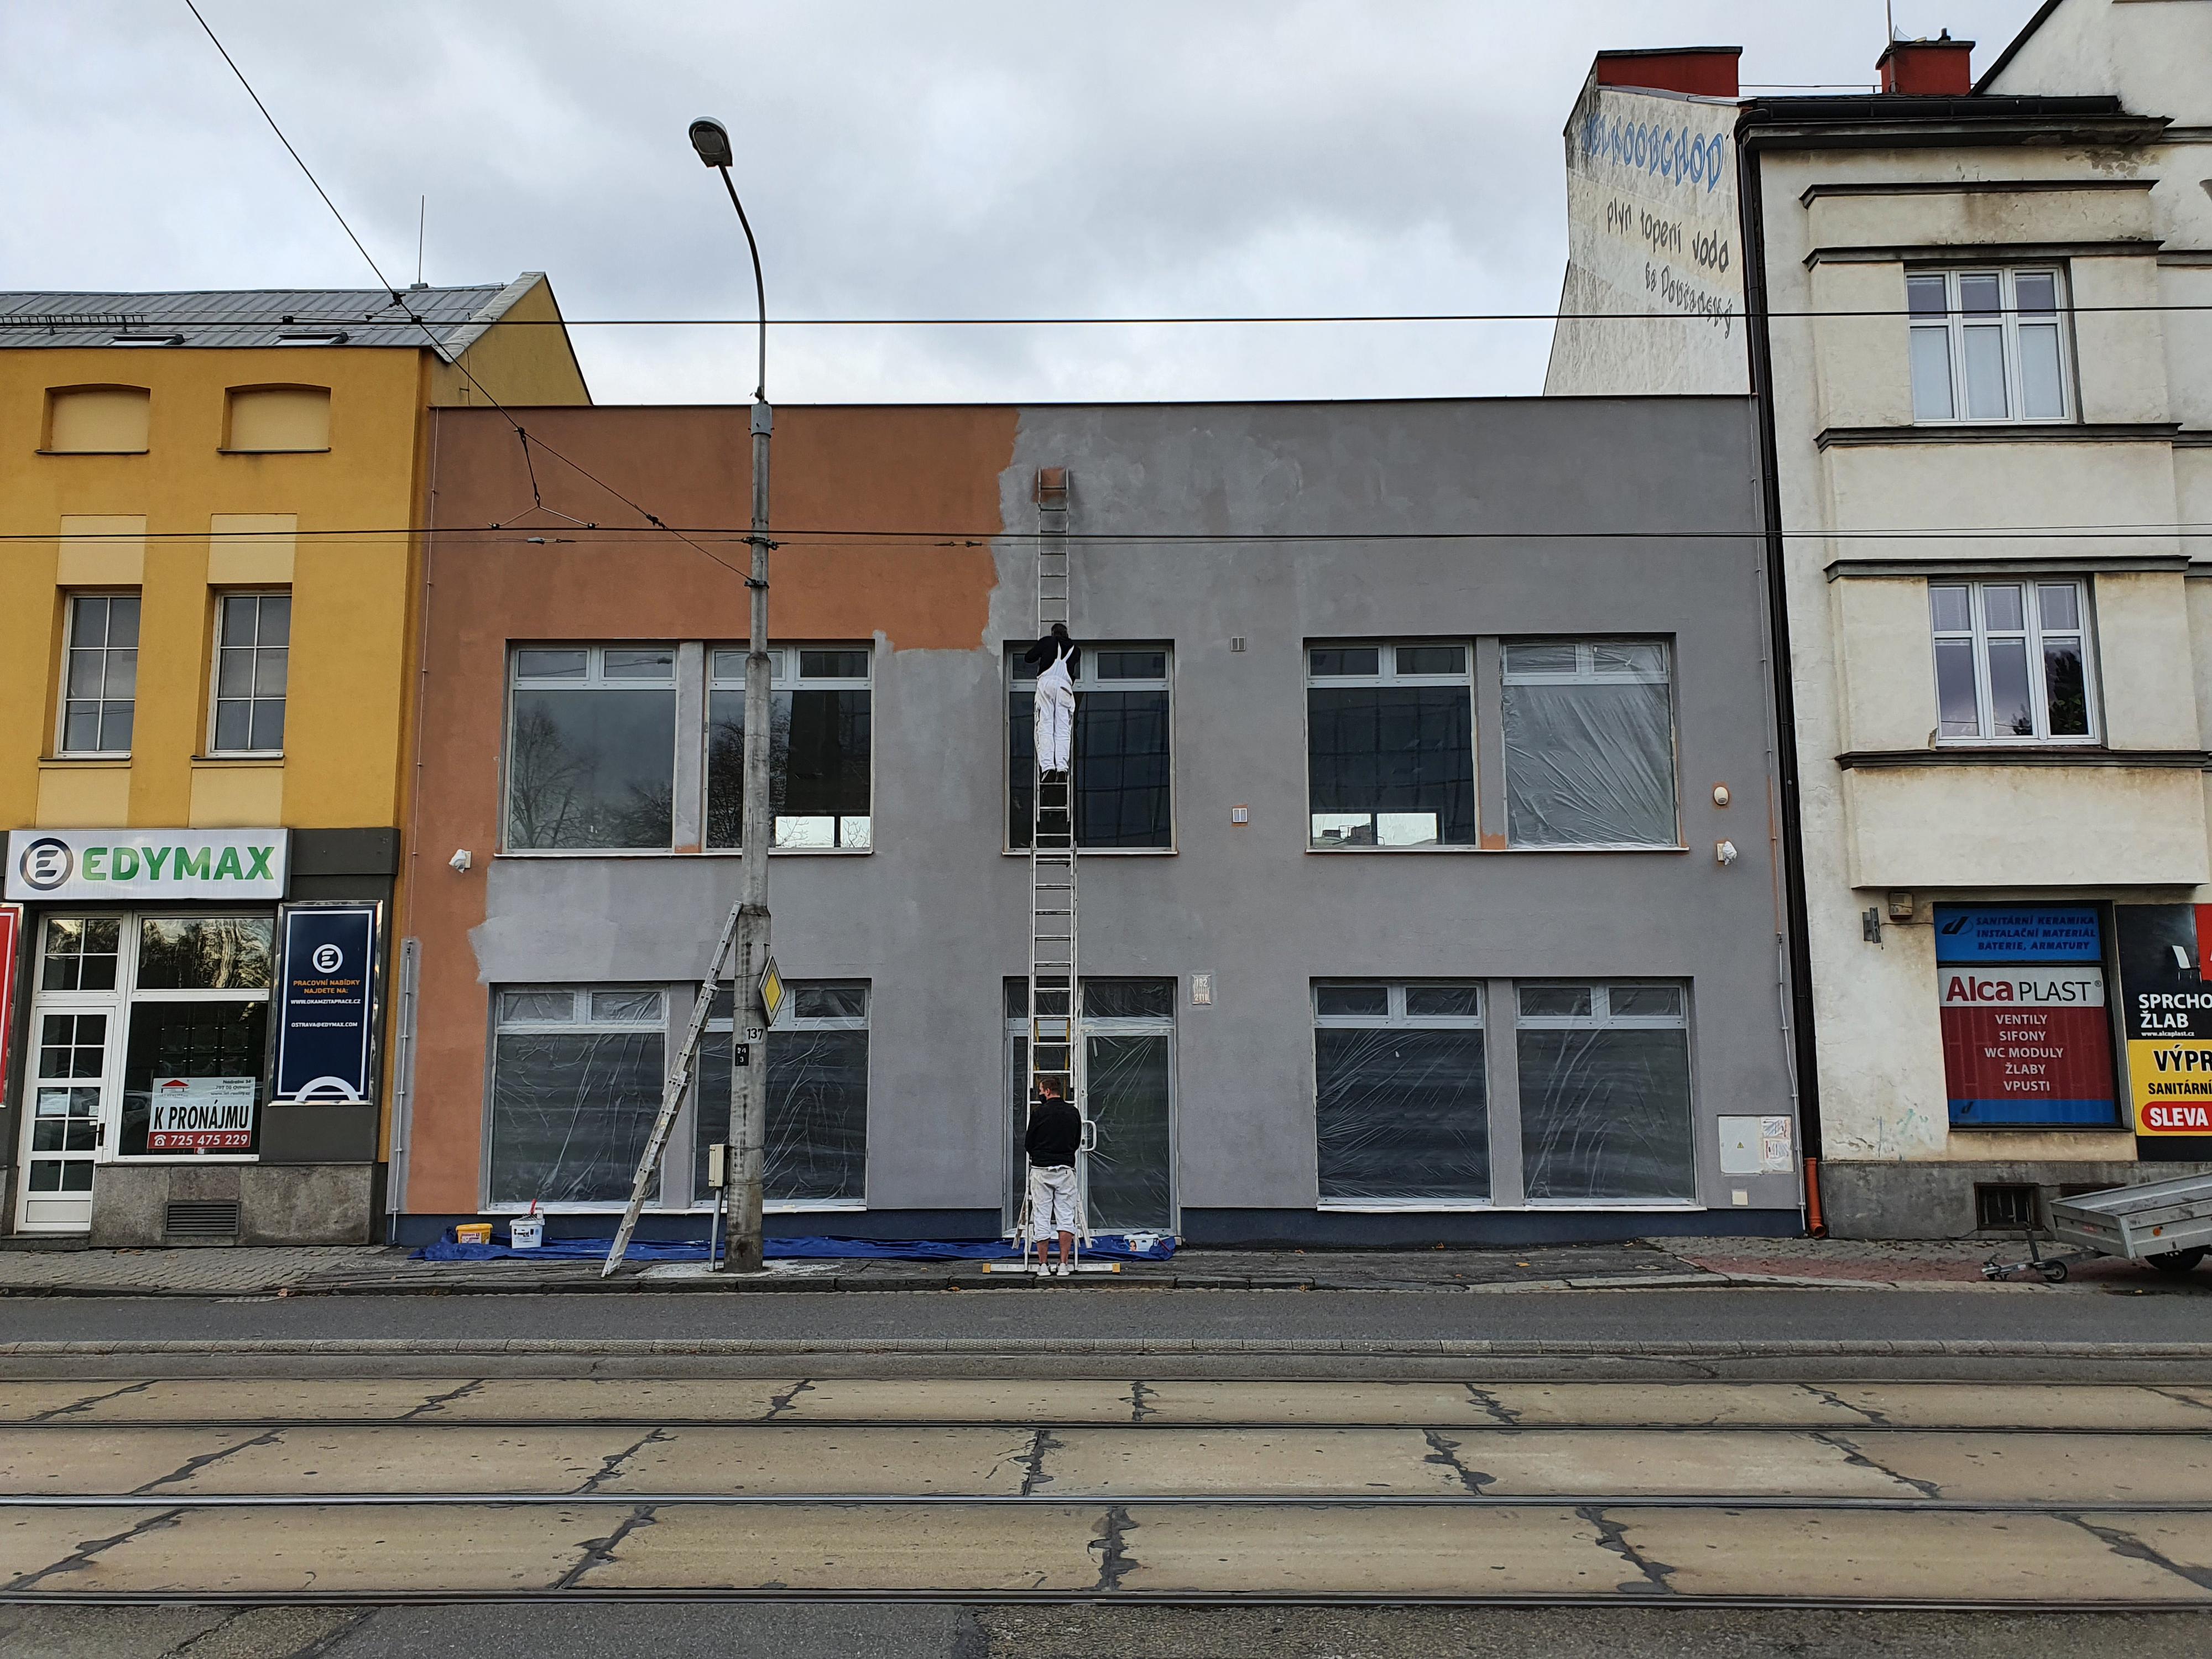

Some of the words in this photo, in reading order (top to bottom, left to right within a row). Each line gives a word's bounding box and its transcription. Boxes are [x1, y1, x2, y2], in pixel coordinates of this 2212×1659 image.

[1607, 196, 1631, 235] plyn
[1640, 207, 1682, 254] topení
[1692, 229, 1729, 273] voda
[82, 847, 275, 880] EDYMAX
[1976, 915, 2033, 925] SANITÁRNÍ
[2038, 916, 2094, 925] KERAMIKA
[1977, 928, 2038, 937] INSTALAČNÍ
[2042, 927, 2096, 937] MATERIÁL
[1978, 942, 2026, 951] BATERIE,
[2030, 942, 2089, 950] ARMATURY
[1946, 976, 2014, 1001] Alca
[2018, 982, 2091, 1001] PLAST
[2138, 994, 2212, 1009] SPRCHO
[1995, 1014, 2047, 1025] VENTILY
[2140, 1010, 2189, 1028] ŽLAB
[747, 1028, 764, 1040] 137
[2000, 1031, 2046, 1041] SIFONY
[1984, 1047, 2005, 1057] WC
[2008, 1047, 2064, 1058] MODULY
[2153, 1044, 2212, 1071] VÝPR
[2005, 1062, 2046, 1075] ŽLABY
[2003, 1081, 2051, 1091] VPUSTI
[2148, 1079, 2212, 1094] SANITÁRNÍ
[154, 1107, 164, 1129] K
[168, 1099, 249, 1129] PRONÁJMU
[2150, 1107, 2208, 1126] SLEVA
[170, 1135, 194, 1146] 725
[197, 1135, 221, 1145] 475
[225, 1134, 248, 1145] 229
